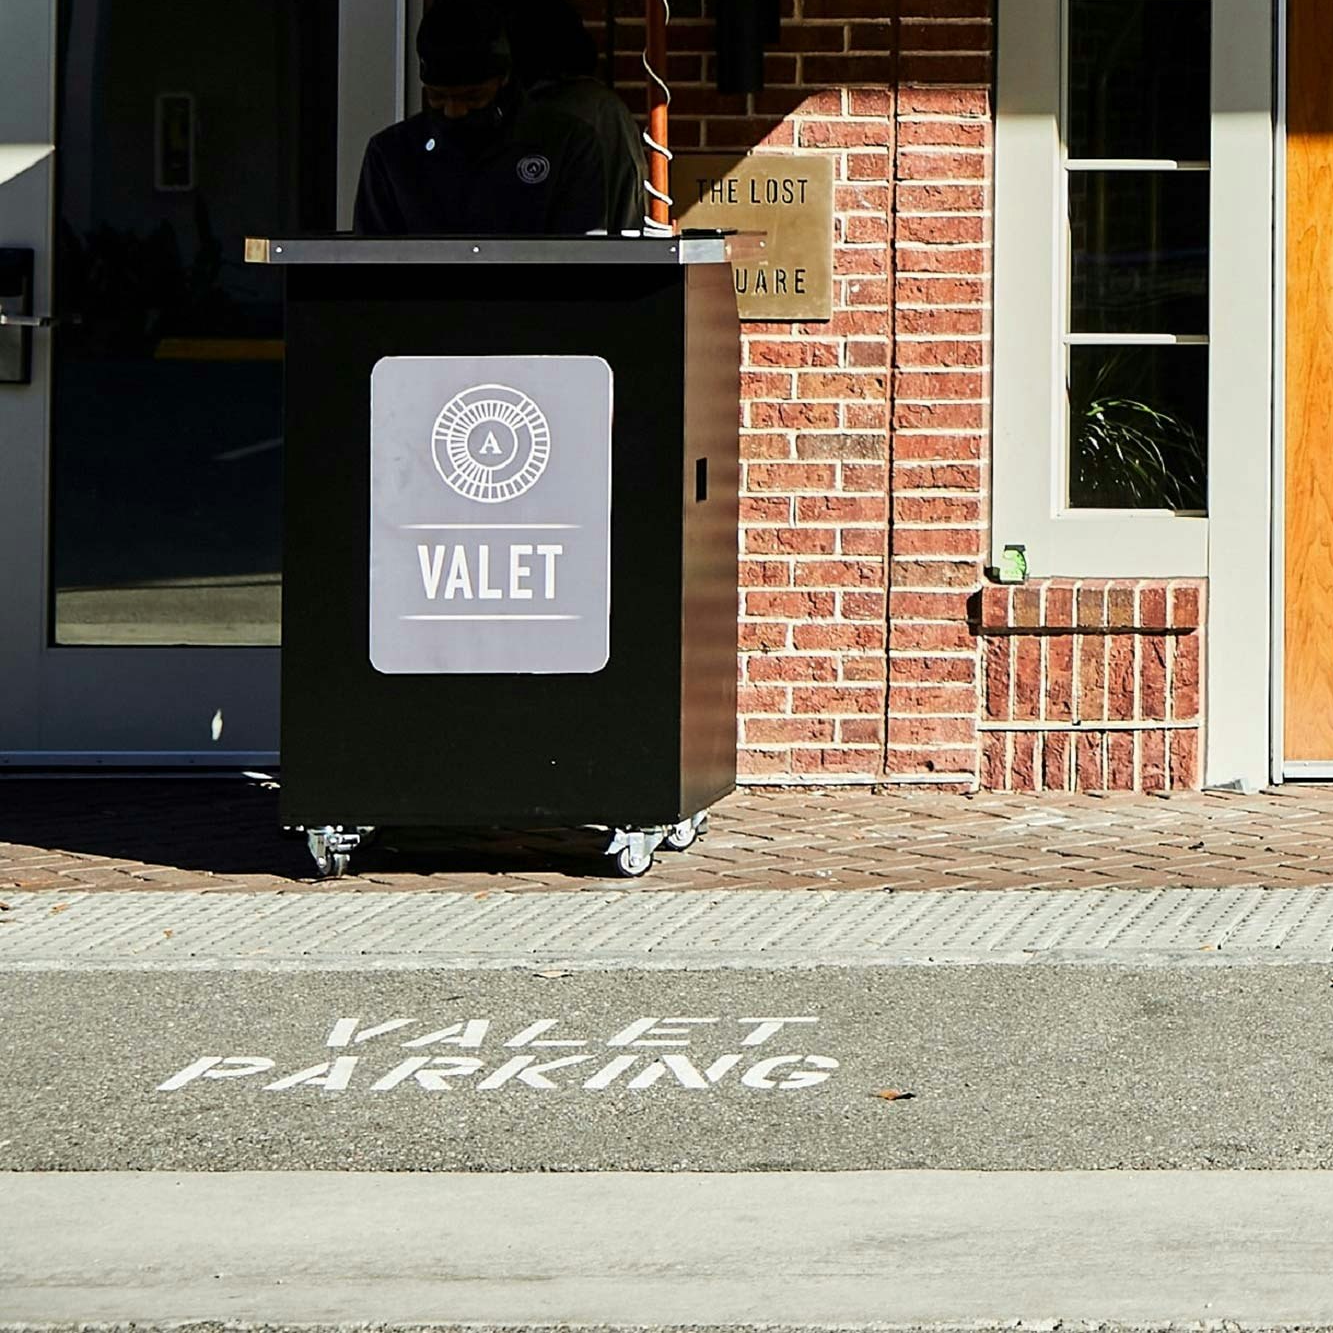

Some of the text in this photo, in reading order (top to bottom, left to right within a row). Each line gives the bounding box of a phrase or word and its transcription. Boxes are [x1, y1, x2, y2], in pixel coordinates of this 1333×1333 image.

[696, 178, 808, 204] THE LOST
[735, 268, 806, 294] UARE
[479, 432, 503, 455] A
[417, 544, 563, 600] VALET
[325, 1017, 818, 1047] VALET
[156, 1055, 840, 1091] PARKING
